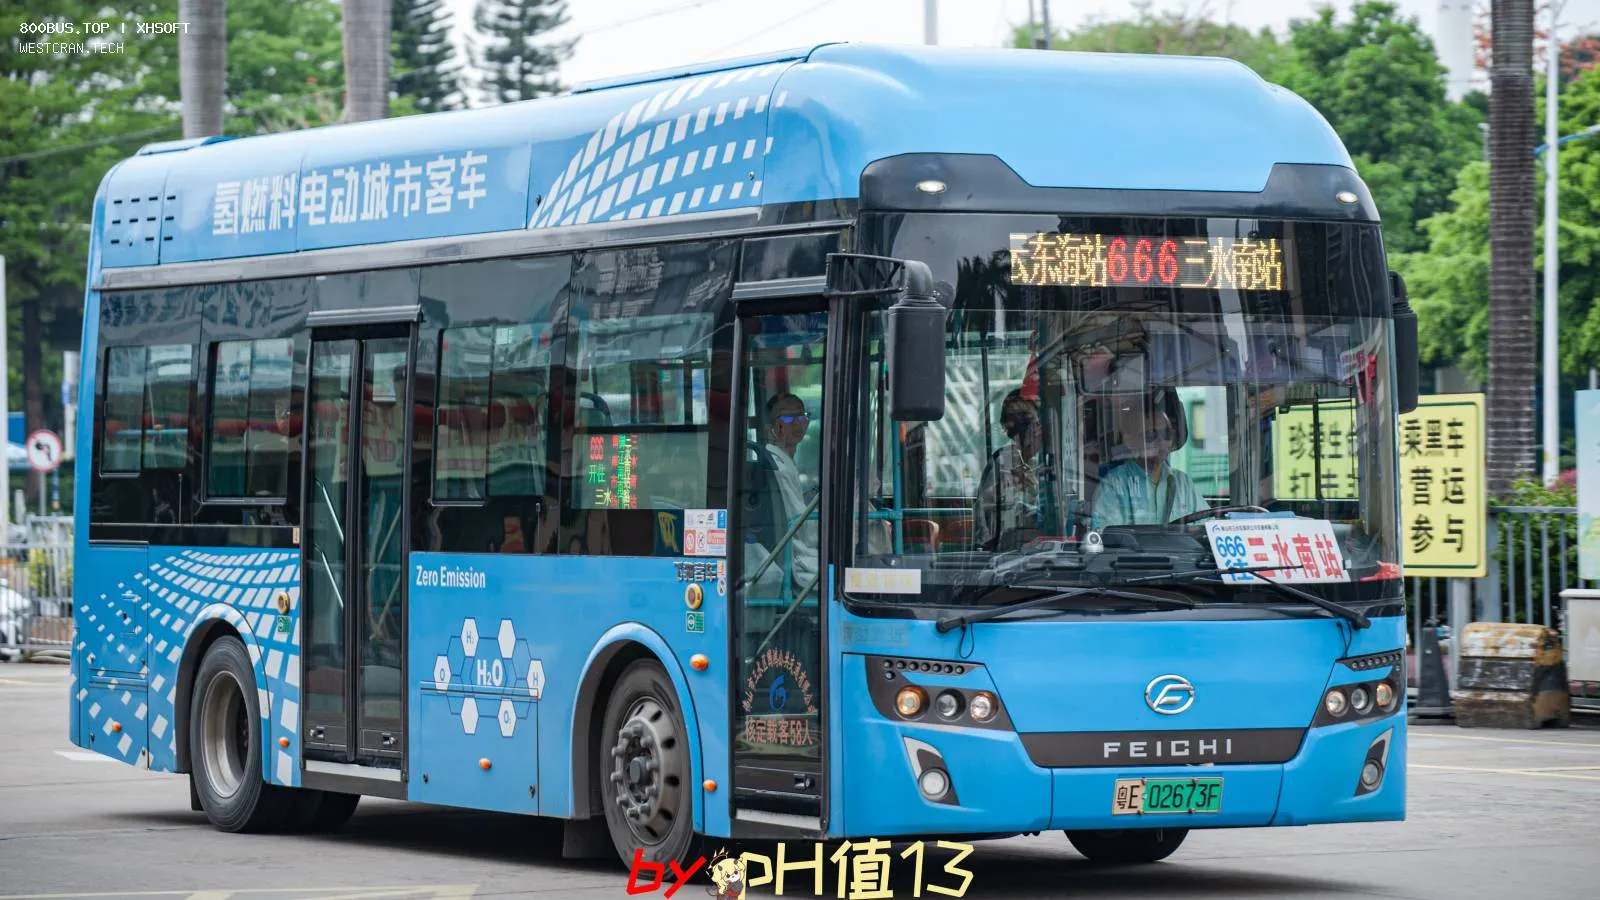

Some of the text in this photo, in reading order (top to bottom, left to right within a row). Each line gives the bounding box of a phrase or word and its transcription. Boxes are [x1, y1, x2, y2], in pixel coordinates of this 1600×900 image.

[212, 150, 488, 236] 氢燃料电动城市客车
[1107, 237, 1179, 284] 666
[1181, 236, 1282, 291] 三水南站
[1215, 535, 1247, 558] 666
[1410, 513, 1465, 555] 参与
[416, 565, 486, 589] Zero Emission
[1102, 738, 1232, 759] FEICHI
